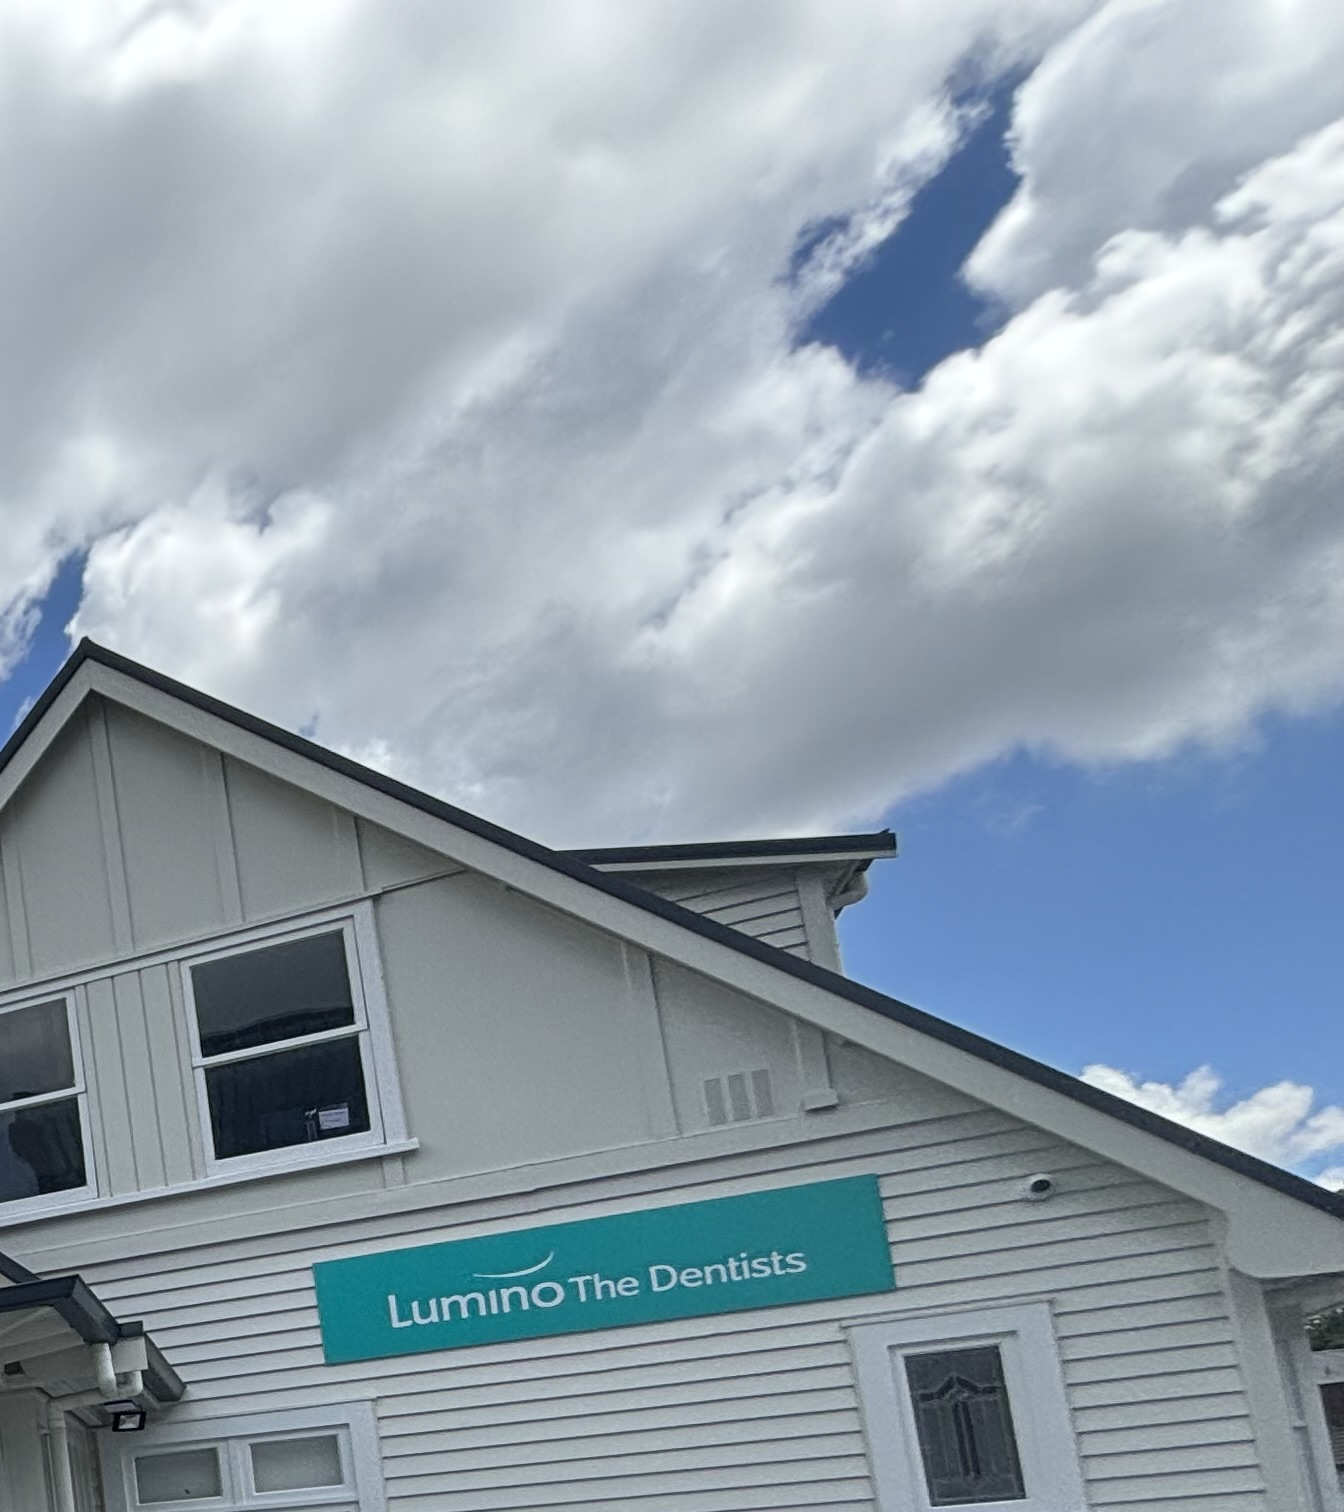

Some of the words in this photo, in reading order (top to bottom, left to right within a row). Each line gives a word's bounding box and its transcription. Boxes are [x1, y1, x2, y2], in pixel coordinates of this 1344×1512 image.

[388, 1281, 565, 1328] Lumino
[568, 1273, 640, 1303] The
[649, 1251, 808, 1292] Dentists
